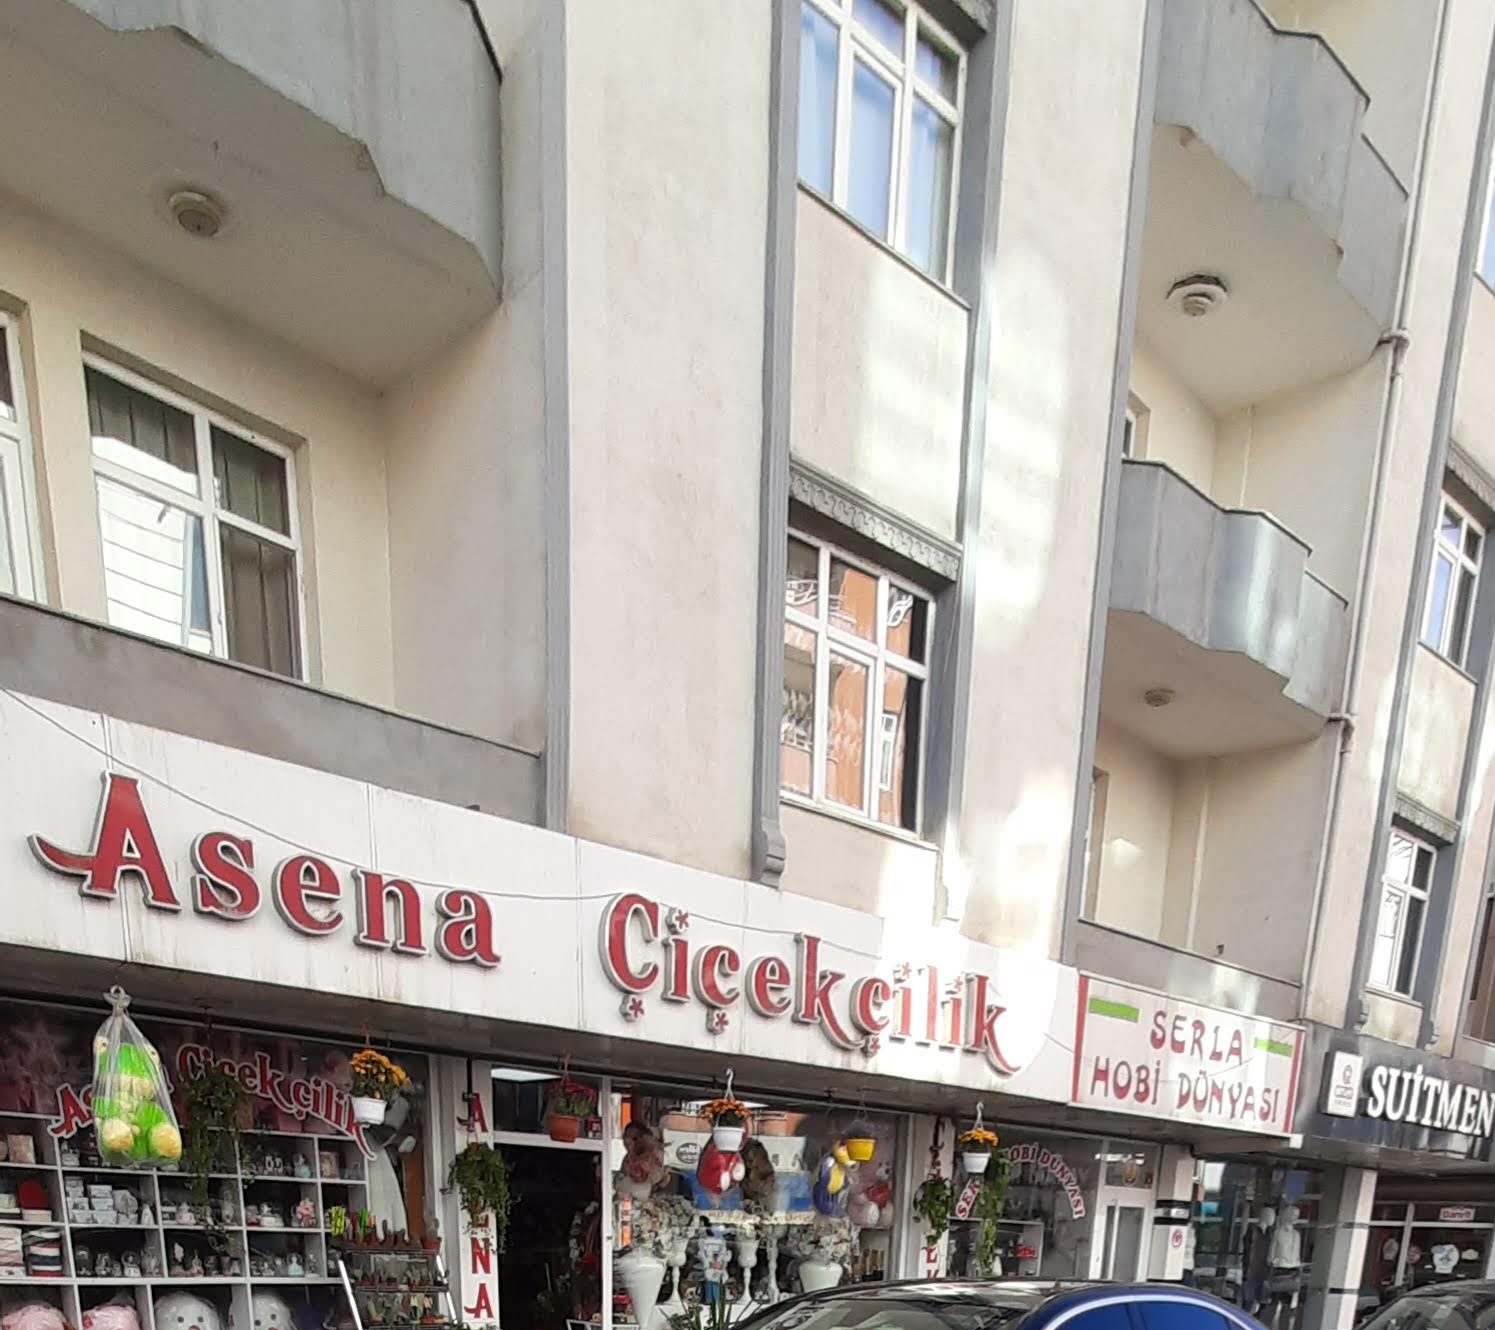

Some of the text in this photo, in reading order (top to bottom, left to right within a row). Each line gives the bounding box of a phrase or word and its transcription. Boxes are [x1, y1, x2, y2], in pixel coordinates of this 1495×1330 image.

[27, 771, 1021, 1077] Asena Çiçekçilik
[1150, 1010, 1243, 1066] SERLA
[1090, 1055, 1281, 1123] HOBİ DÜNYASI
[1367, 1064, 1495, 1138] SUİTMEN
[1008, 1143, 1039, 1163] OBİ
